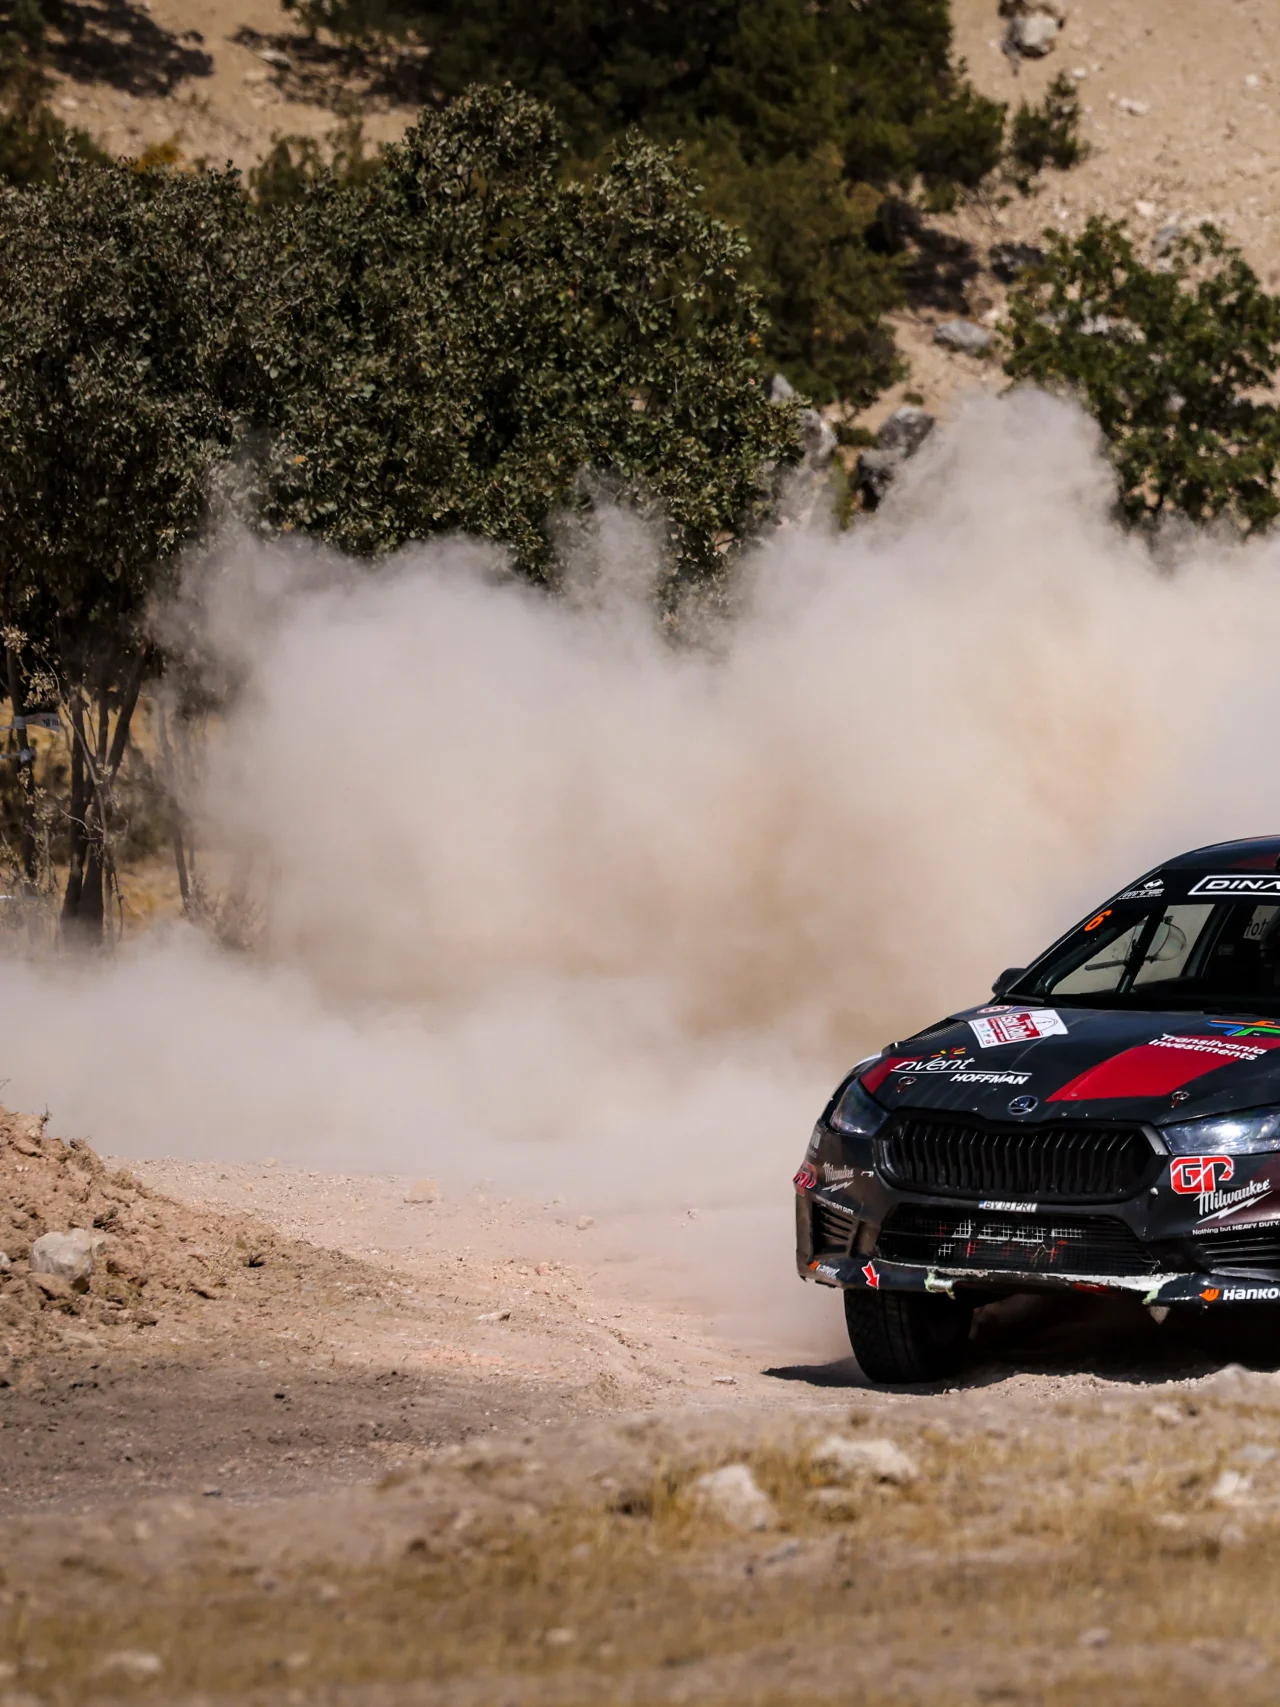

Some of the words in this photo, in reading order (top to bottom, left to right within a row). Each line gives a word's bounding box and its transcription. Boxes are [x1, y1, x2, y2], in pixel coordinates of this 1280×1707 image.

[1084, 909, 1112, 932] 6
[1149, 1038, 1258, 1061] Investments
[1161, 1033, 1267, 1055] Transilvania
[949, 1073, 1030, 1085] HOFFMAN
[1194, 1179, 1271, 1216] Milwaukee
[1192, 1225, 1219, 1236] Nothing
[1219, 1224, 1232, 1232] but
[1232, 1222, 1257, 1231] HEAVY
